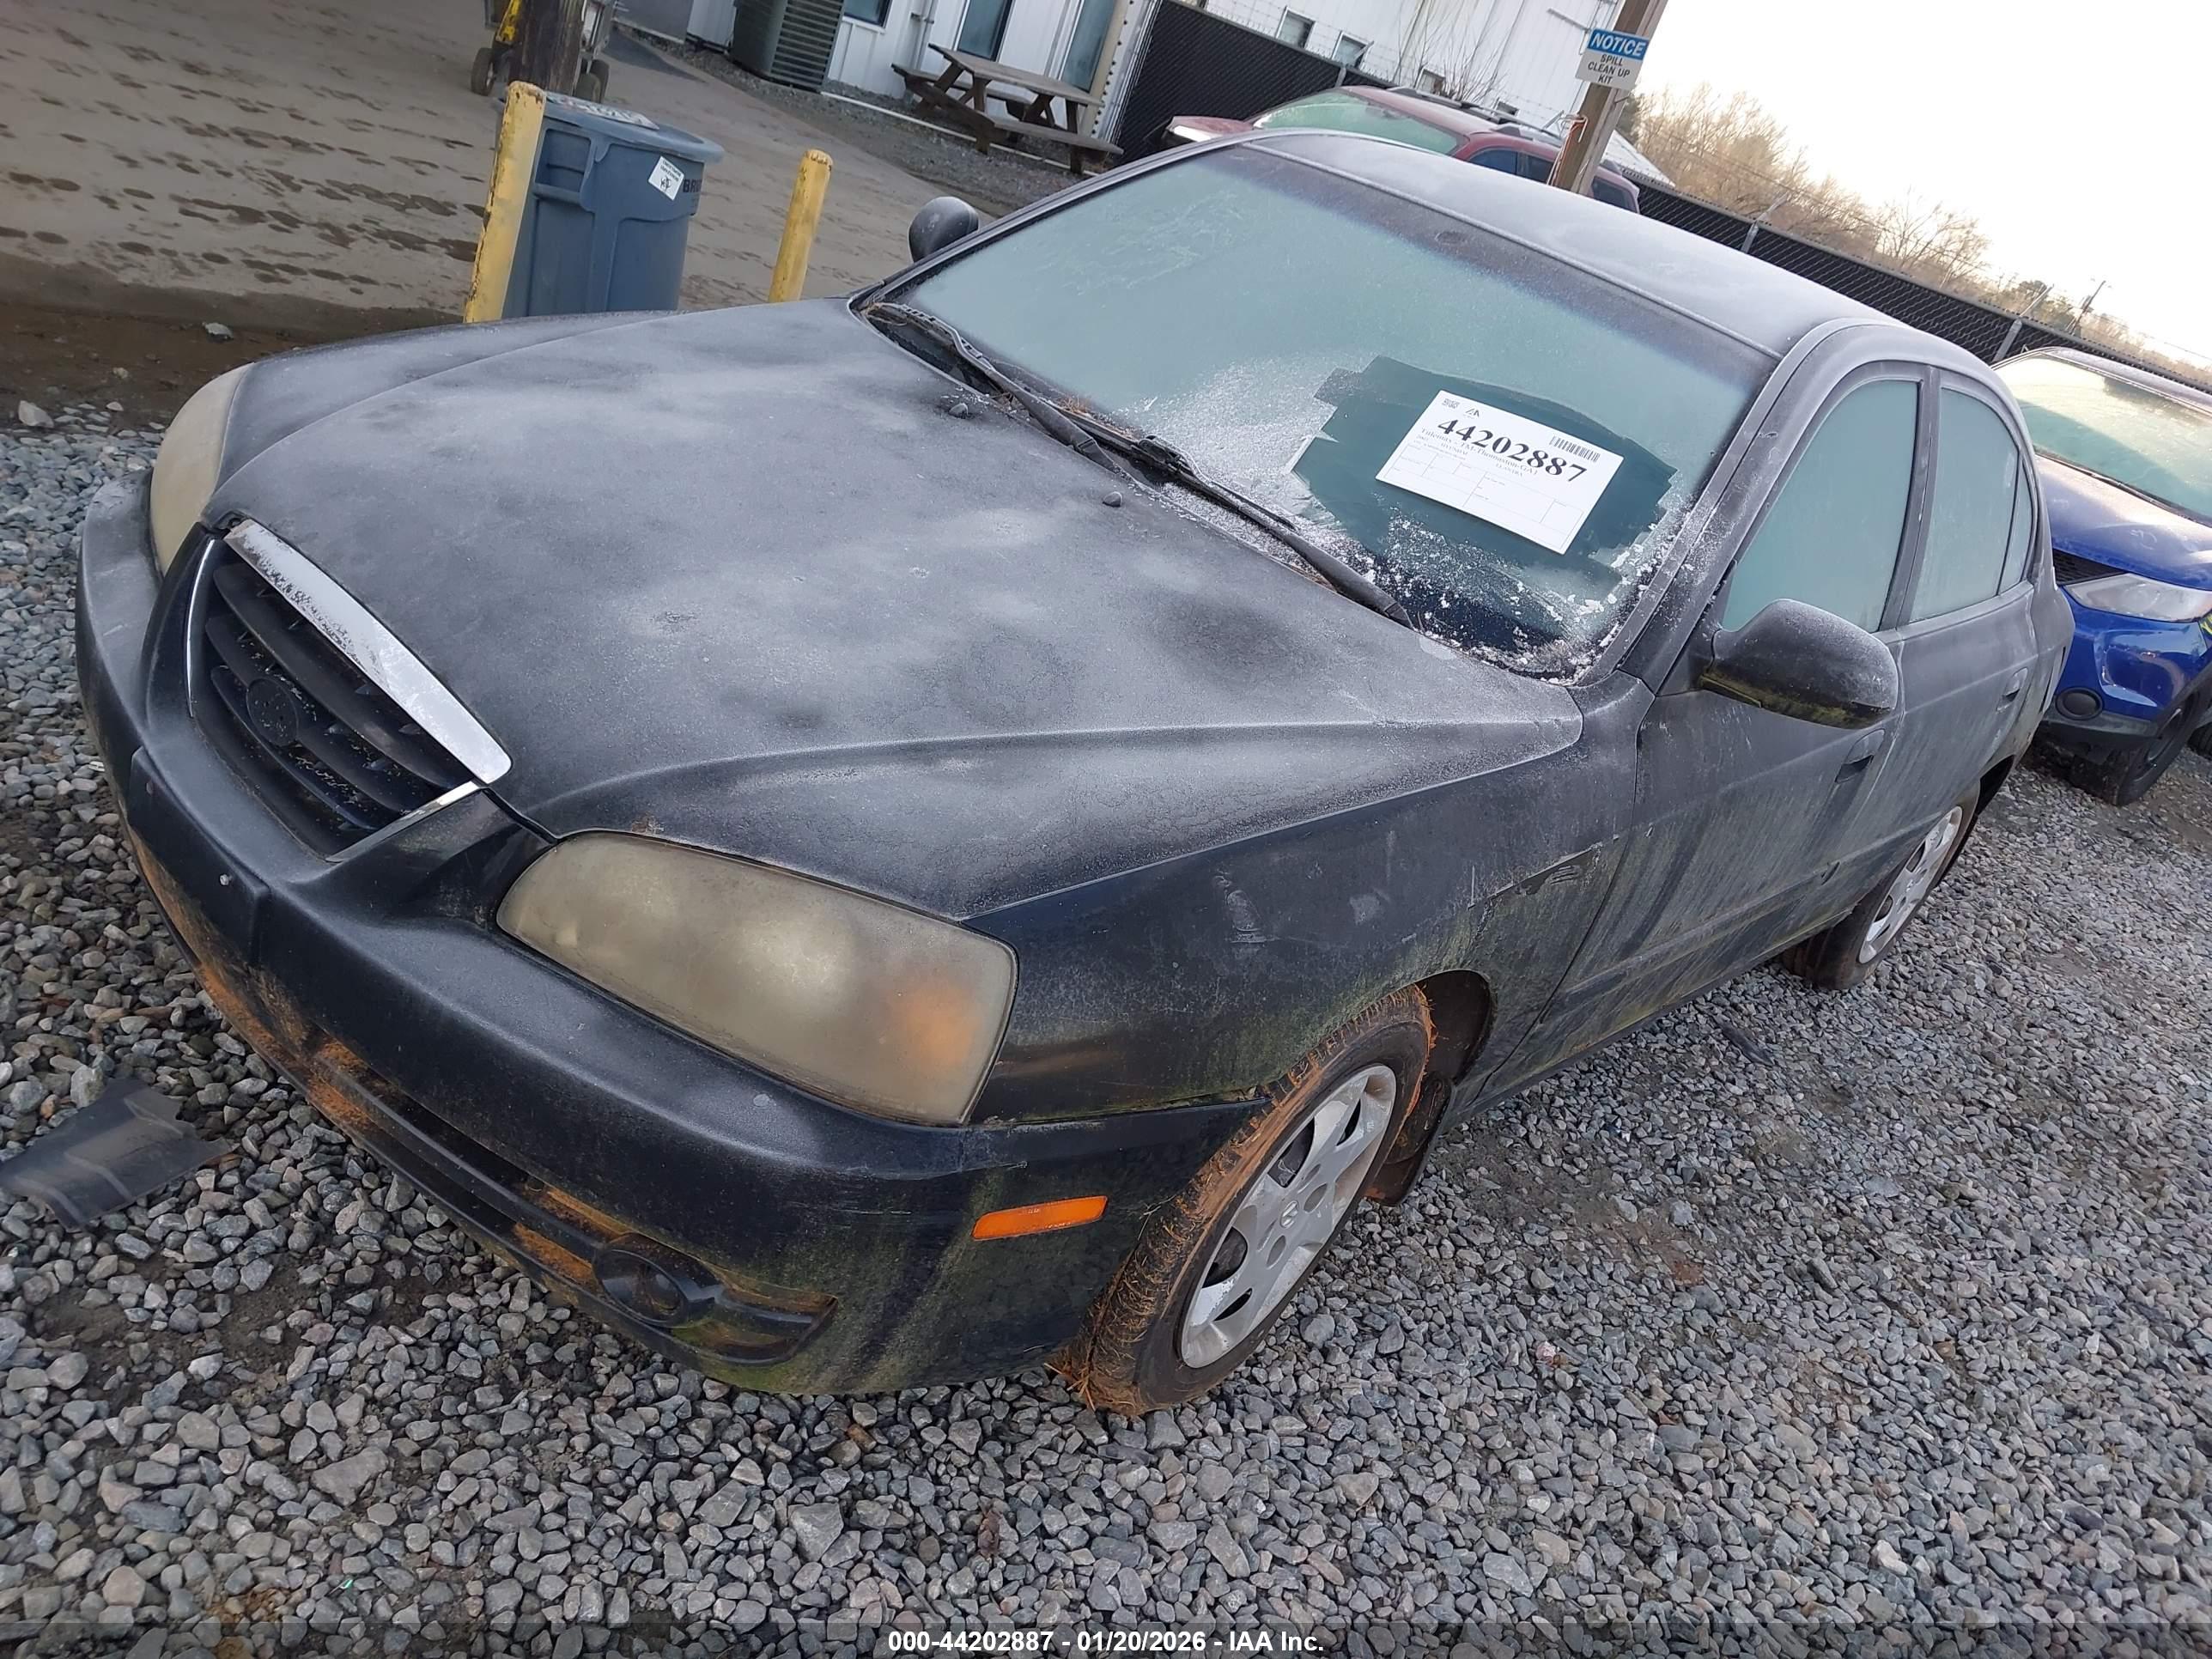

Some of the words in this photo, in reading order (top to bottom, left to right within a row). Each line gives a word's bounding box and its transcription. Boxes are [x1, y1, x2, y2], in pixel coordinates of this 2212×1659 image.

[1591, 33, 1646, 56] NOTICE
[1601, 54, 1622, 66] SPILL
[1588, 62, 1614, 75] CLEAN
[1618, 69, 1630, 77] UP
[1598, 75, 1612, 84] KIT
[1437, 419, 1588, 482] 44202887
